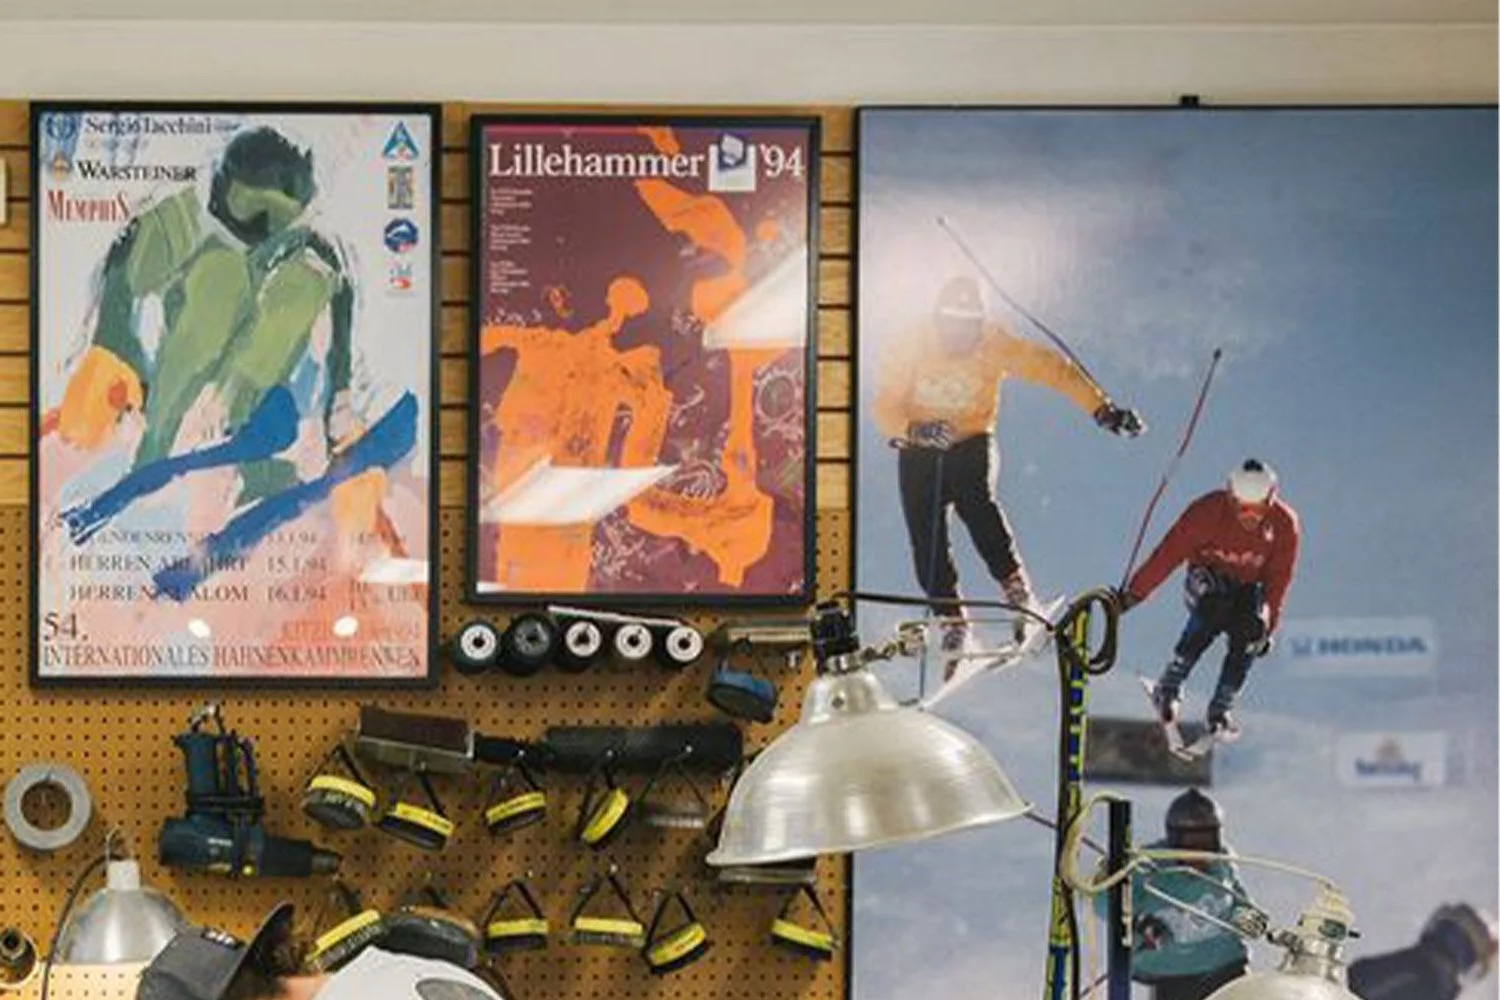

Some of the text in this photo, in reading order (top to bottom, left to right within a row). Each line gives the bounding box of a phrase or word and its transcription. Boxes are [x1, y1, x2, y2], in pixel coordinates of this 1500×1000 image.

[488, 143, 805, 179] Lillehammer '94
[43, 611, 89, 642] 54.
[44, 646, 209, 668] INTERNATIONALES
[1317, 636, 1427, 653] HONDA
